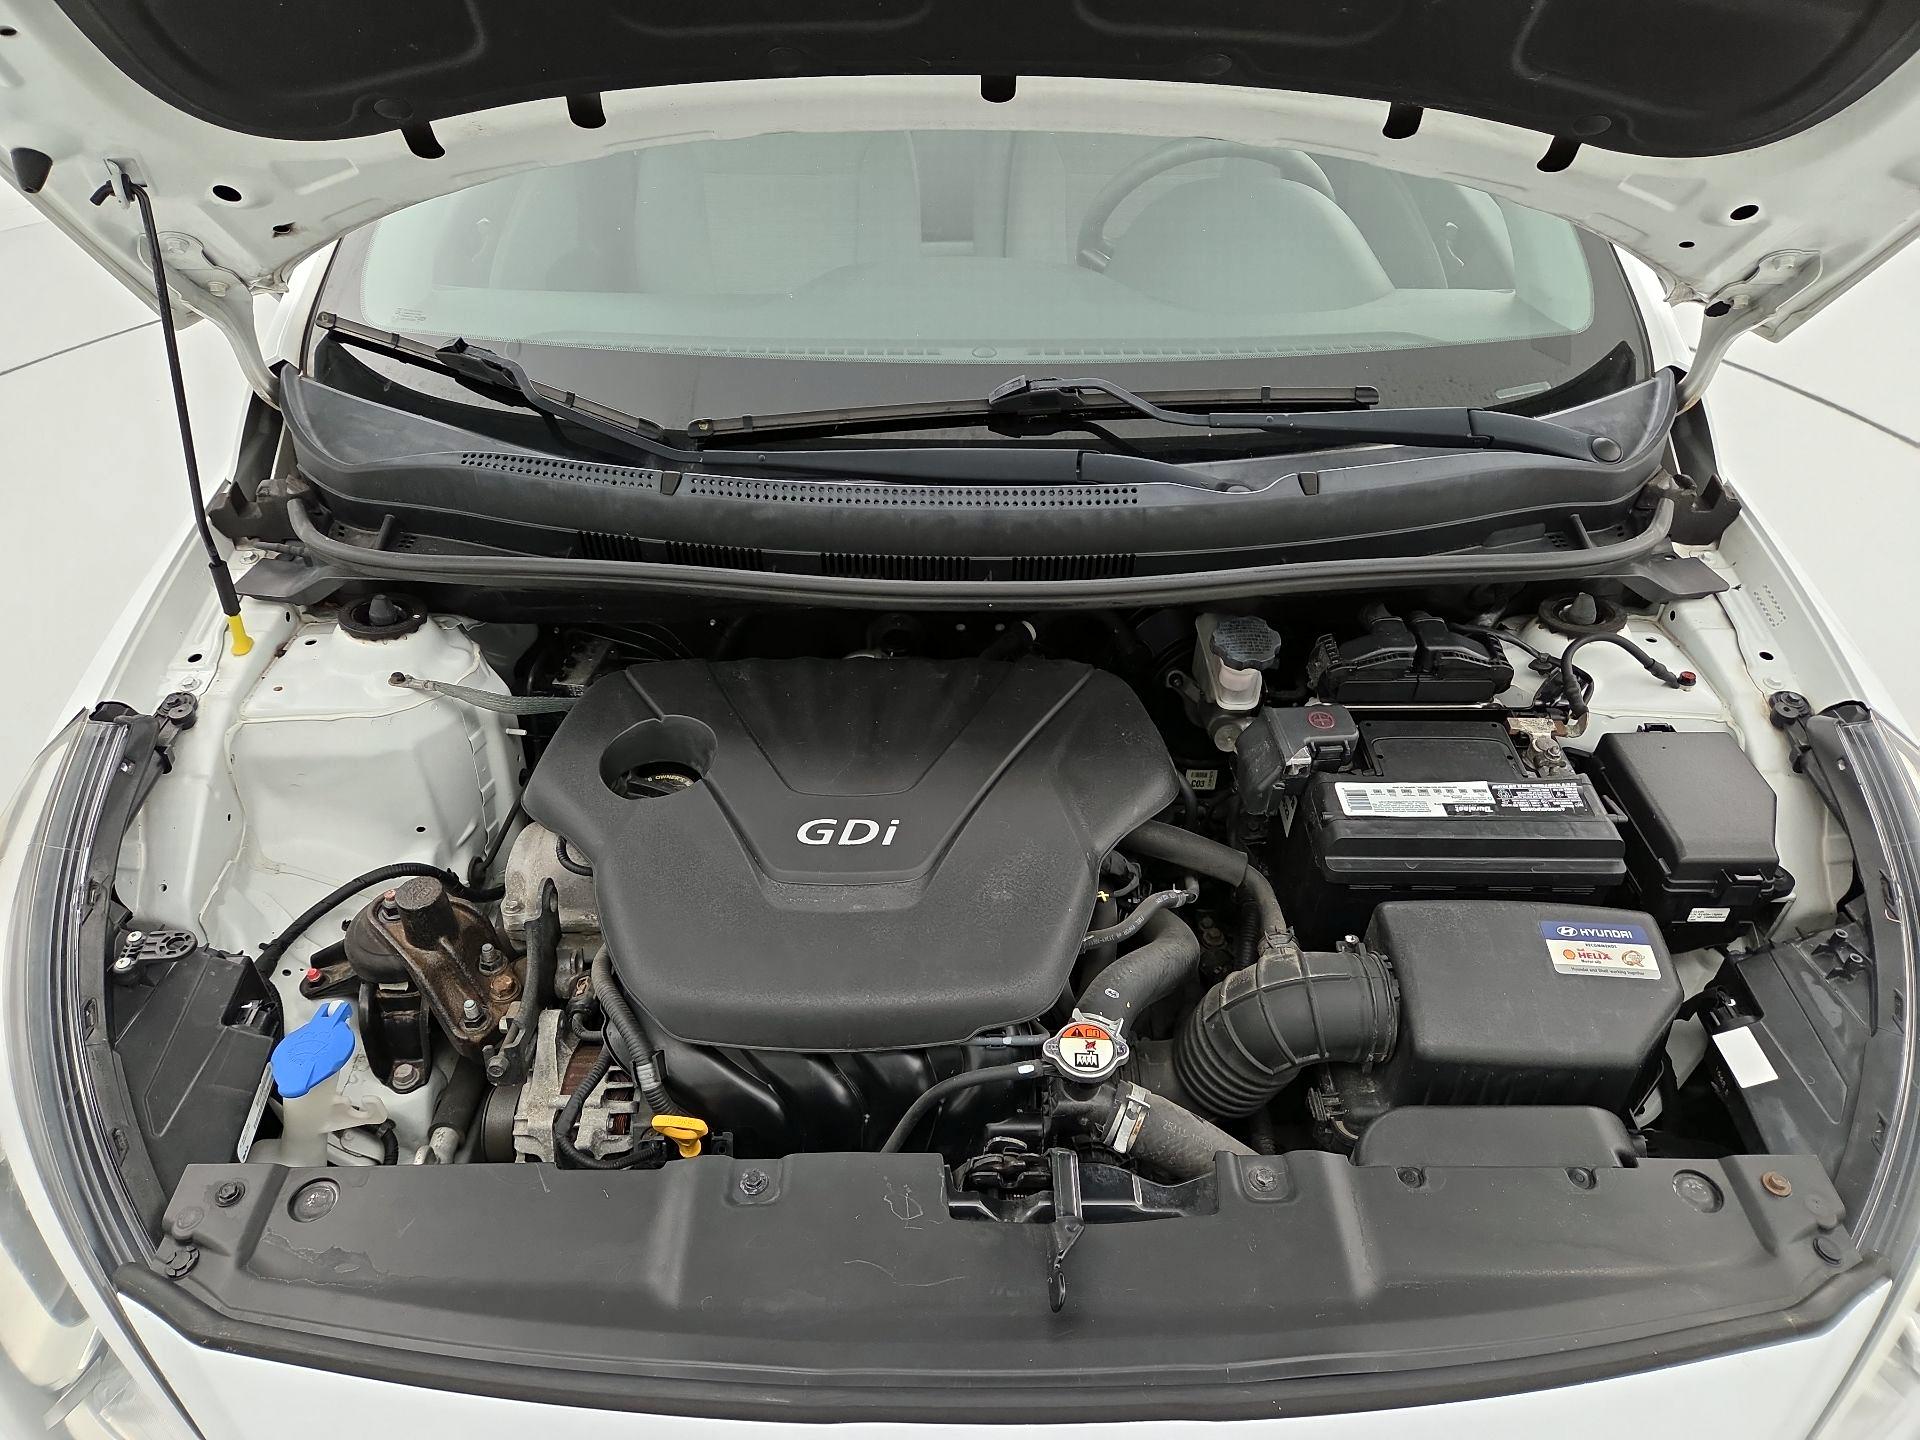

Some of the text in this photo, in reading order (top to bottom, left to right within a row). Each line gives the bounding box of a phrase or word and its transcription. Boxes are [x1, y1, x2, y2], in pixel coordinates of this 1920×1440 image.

[797, 819, 900, 845] GDi
[1580, 928, 1633, 939] HYUNDAI
[1578, 952, 1612, 960] HELIX
